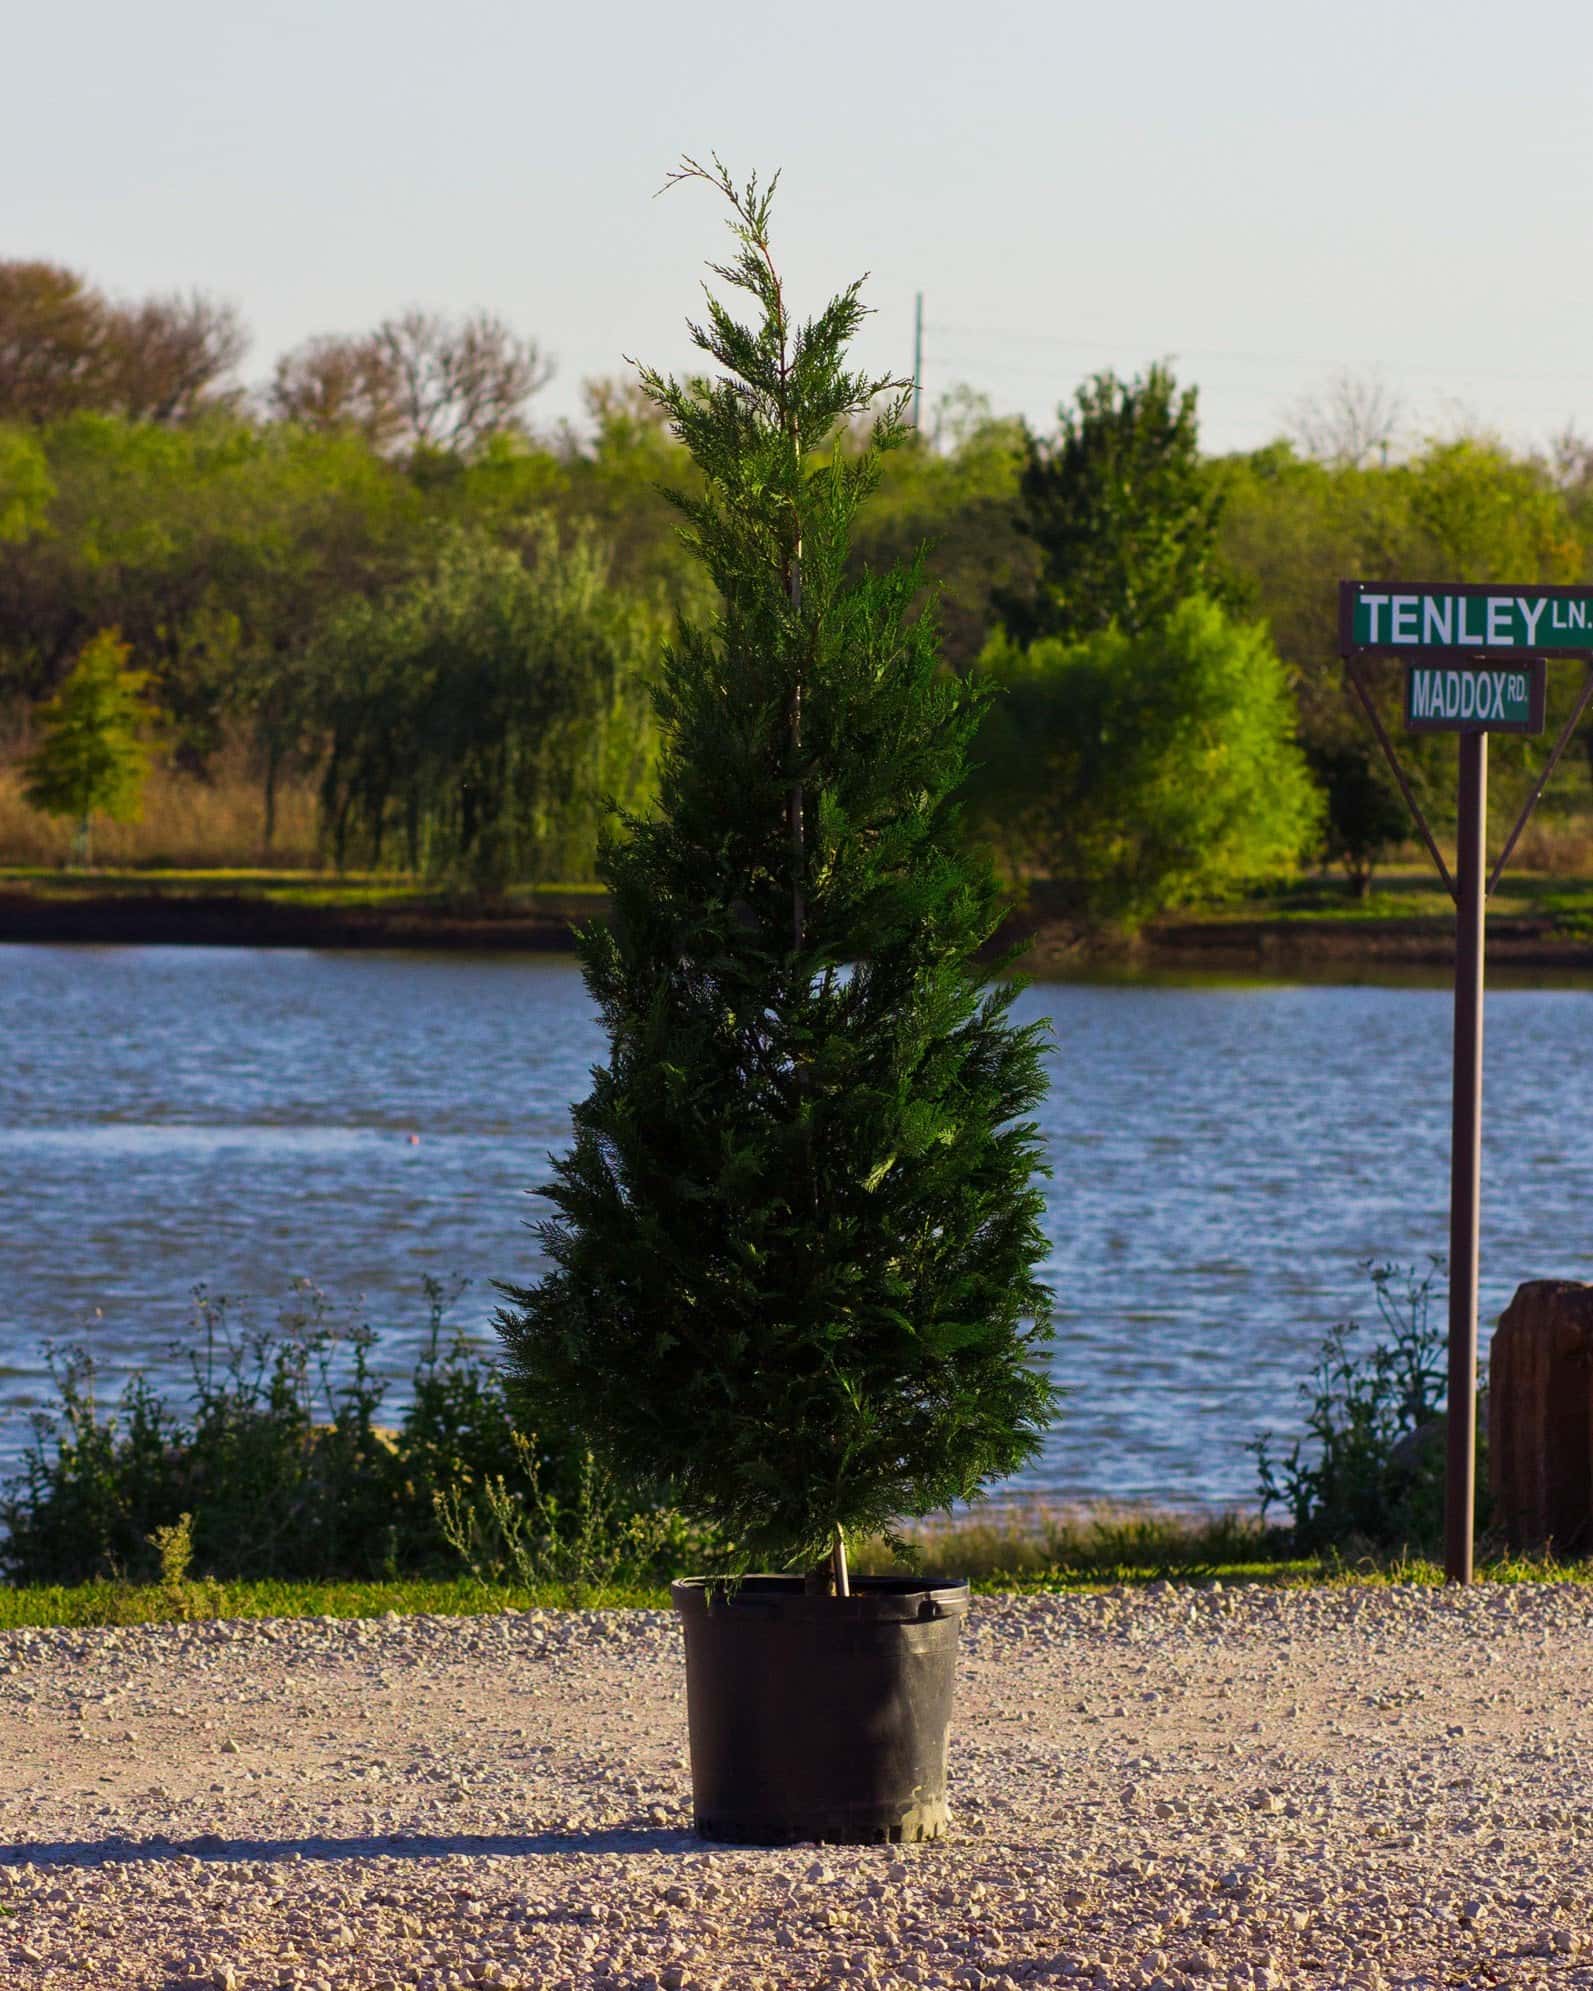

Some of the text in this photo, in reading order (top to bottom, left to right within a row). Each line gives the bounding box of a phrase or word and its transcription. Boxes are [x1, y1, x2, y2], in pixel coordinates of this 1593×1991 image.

[1359, 594, 1593, 646] TENLEY LN.
[1412, 669, 1528, 720] MADDOX RD.
